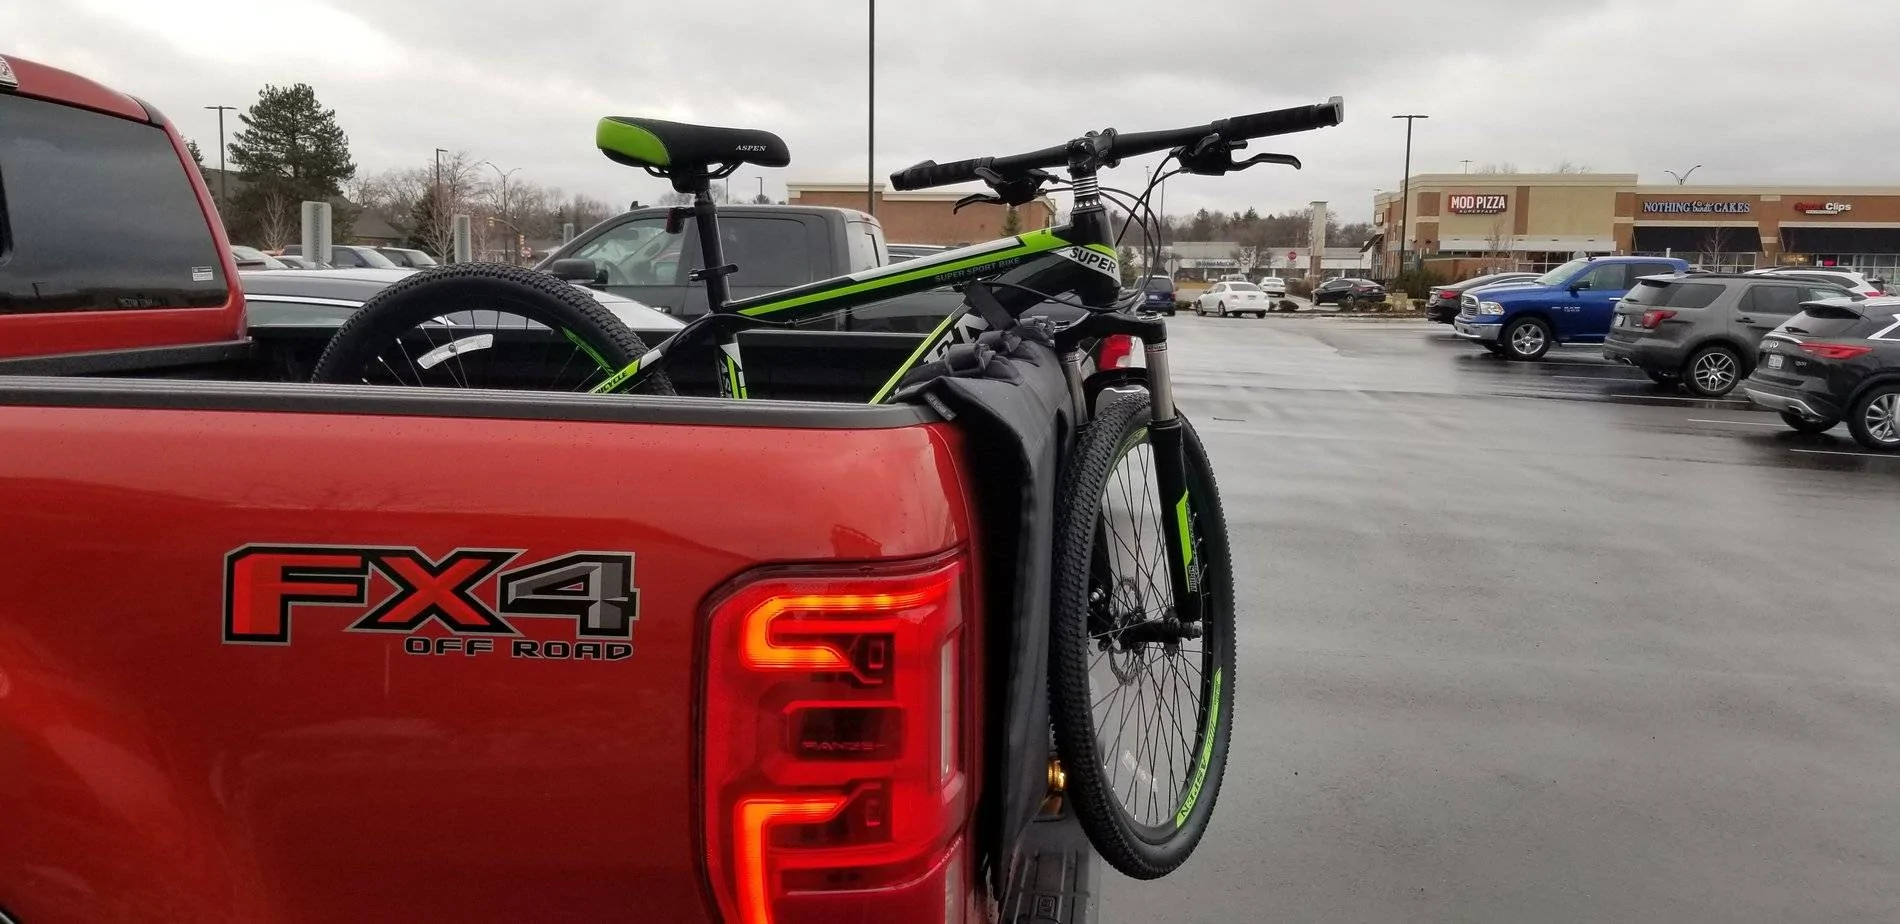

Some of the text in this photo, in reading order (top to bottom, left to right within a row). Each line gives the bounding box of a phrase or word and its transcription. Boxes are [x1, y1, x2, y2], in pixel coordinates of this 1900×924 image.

[735, 144, 767, 152] ASPEN
[1451, 195, 1506, 209] MOD PIZZA
[1643, 201, 1691, 213] NOTHING
[1714, 202, 1751, 213] CAKES
[1825, 202, 1853, 212] Clips
[1068, 246, 1118, 274] SUPER
[934, 257, 1021, 283] SUPER SPORT BIKE
[222, 542, 642, 646] FX4
[404, 637, 635, 661] OFF ROAD
